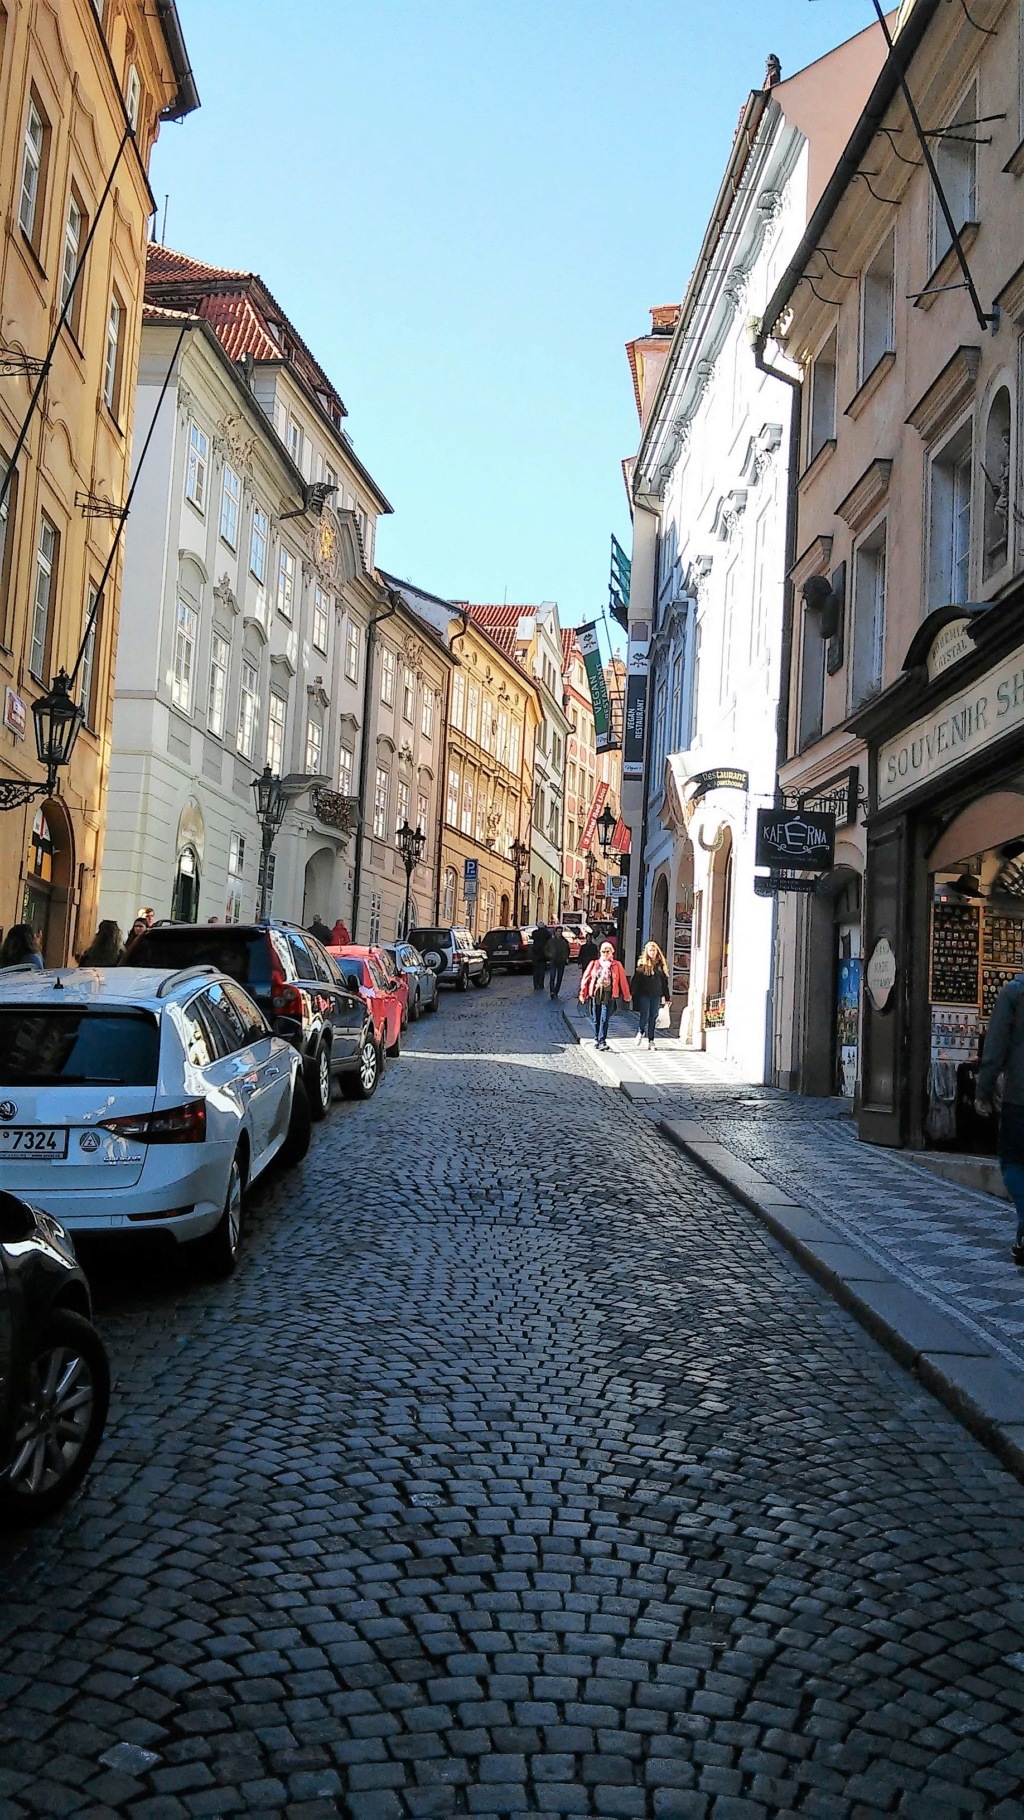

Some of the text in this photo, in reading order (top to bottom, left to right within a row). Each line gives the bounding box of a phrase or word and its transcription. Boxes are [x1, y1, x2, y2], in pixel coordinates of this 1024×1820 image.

[589, 674, 602, 715] VEGAN
[626, 708, 636, 730] VEGAN
[634, 698, 645, 739] RESTAURANT
[887, 697, 991, 784] SOUVENIR
[585, 788, 607, 838] Hotel Red Lion
[12, 1131, 57, 1150] 7324
